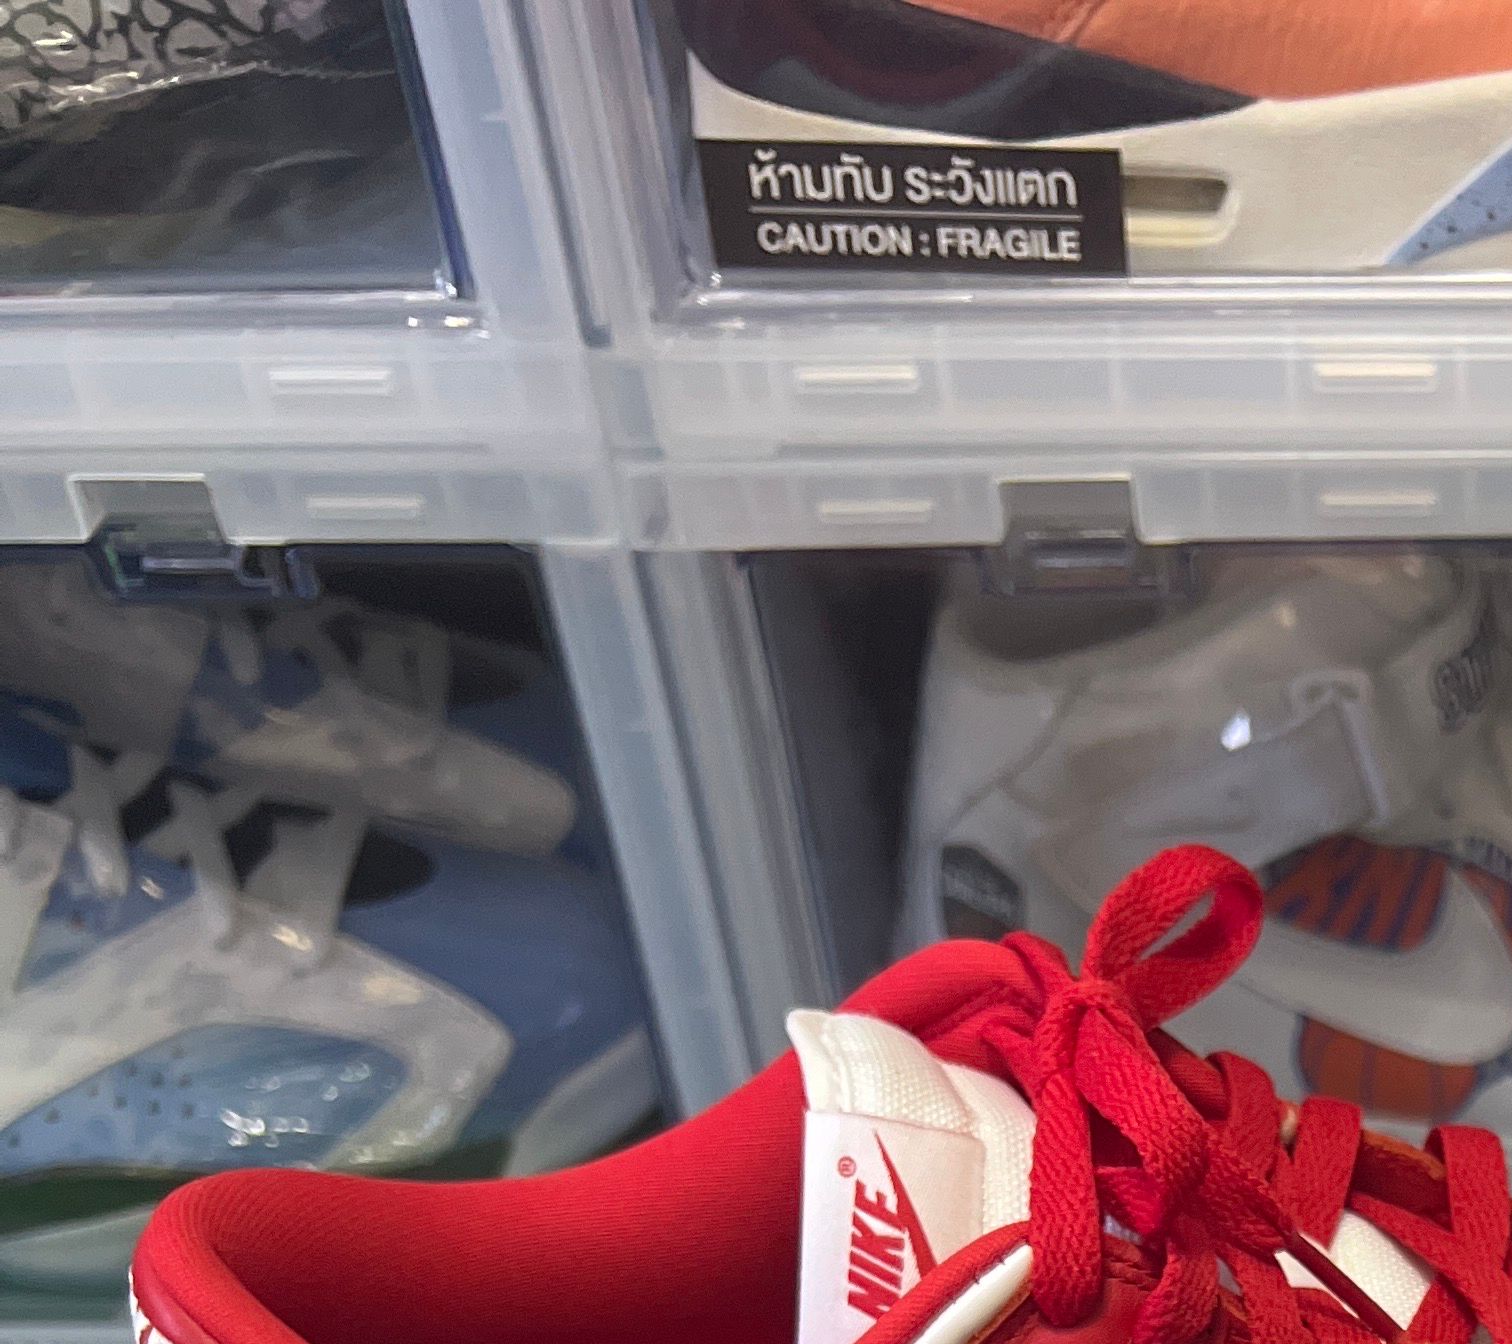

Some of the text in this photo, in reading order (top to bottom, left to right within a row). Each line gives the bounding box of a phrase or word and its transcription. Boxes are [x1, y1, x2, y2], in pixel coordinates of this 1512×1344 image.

[756, 220, 913, 257] CAUTION
[936, 223, 1083, 261] FRAGILE
[847, 1177, 906, 1322] NIKE
